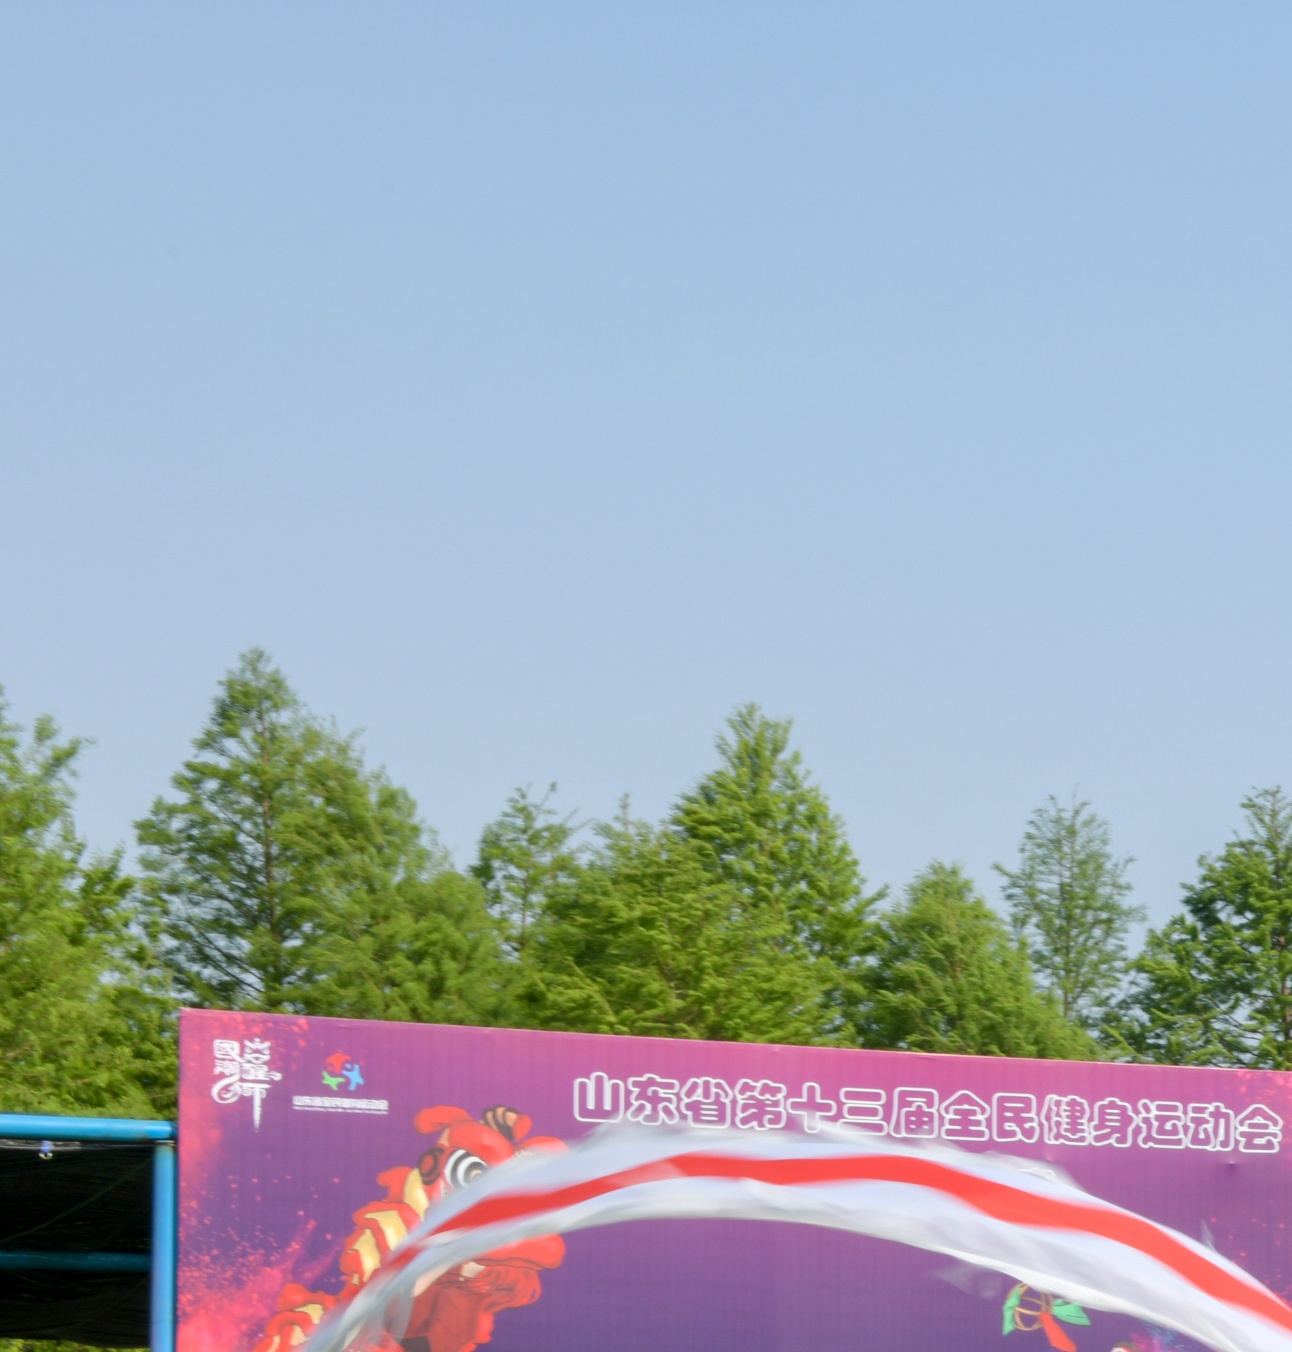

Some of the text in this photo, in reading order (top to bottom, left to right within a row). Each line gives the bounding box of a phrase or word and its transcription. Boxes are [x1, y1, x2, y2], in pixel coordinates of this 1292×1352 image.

[573, 1071, 1283, 1153] 山东省第十三届全民健身运动会
